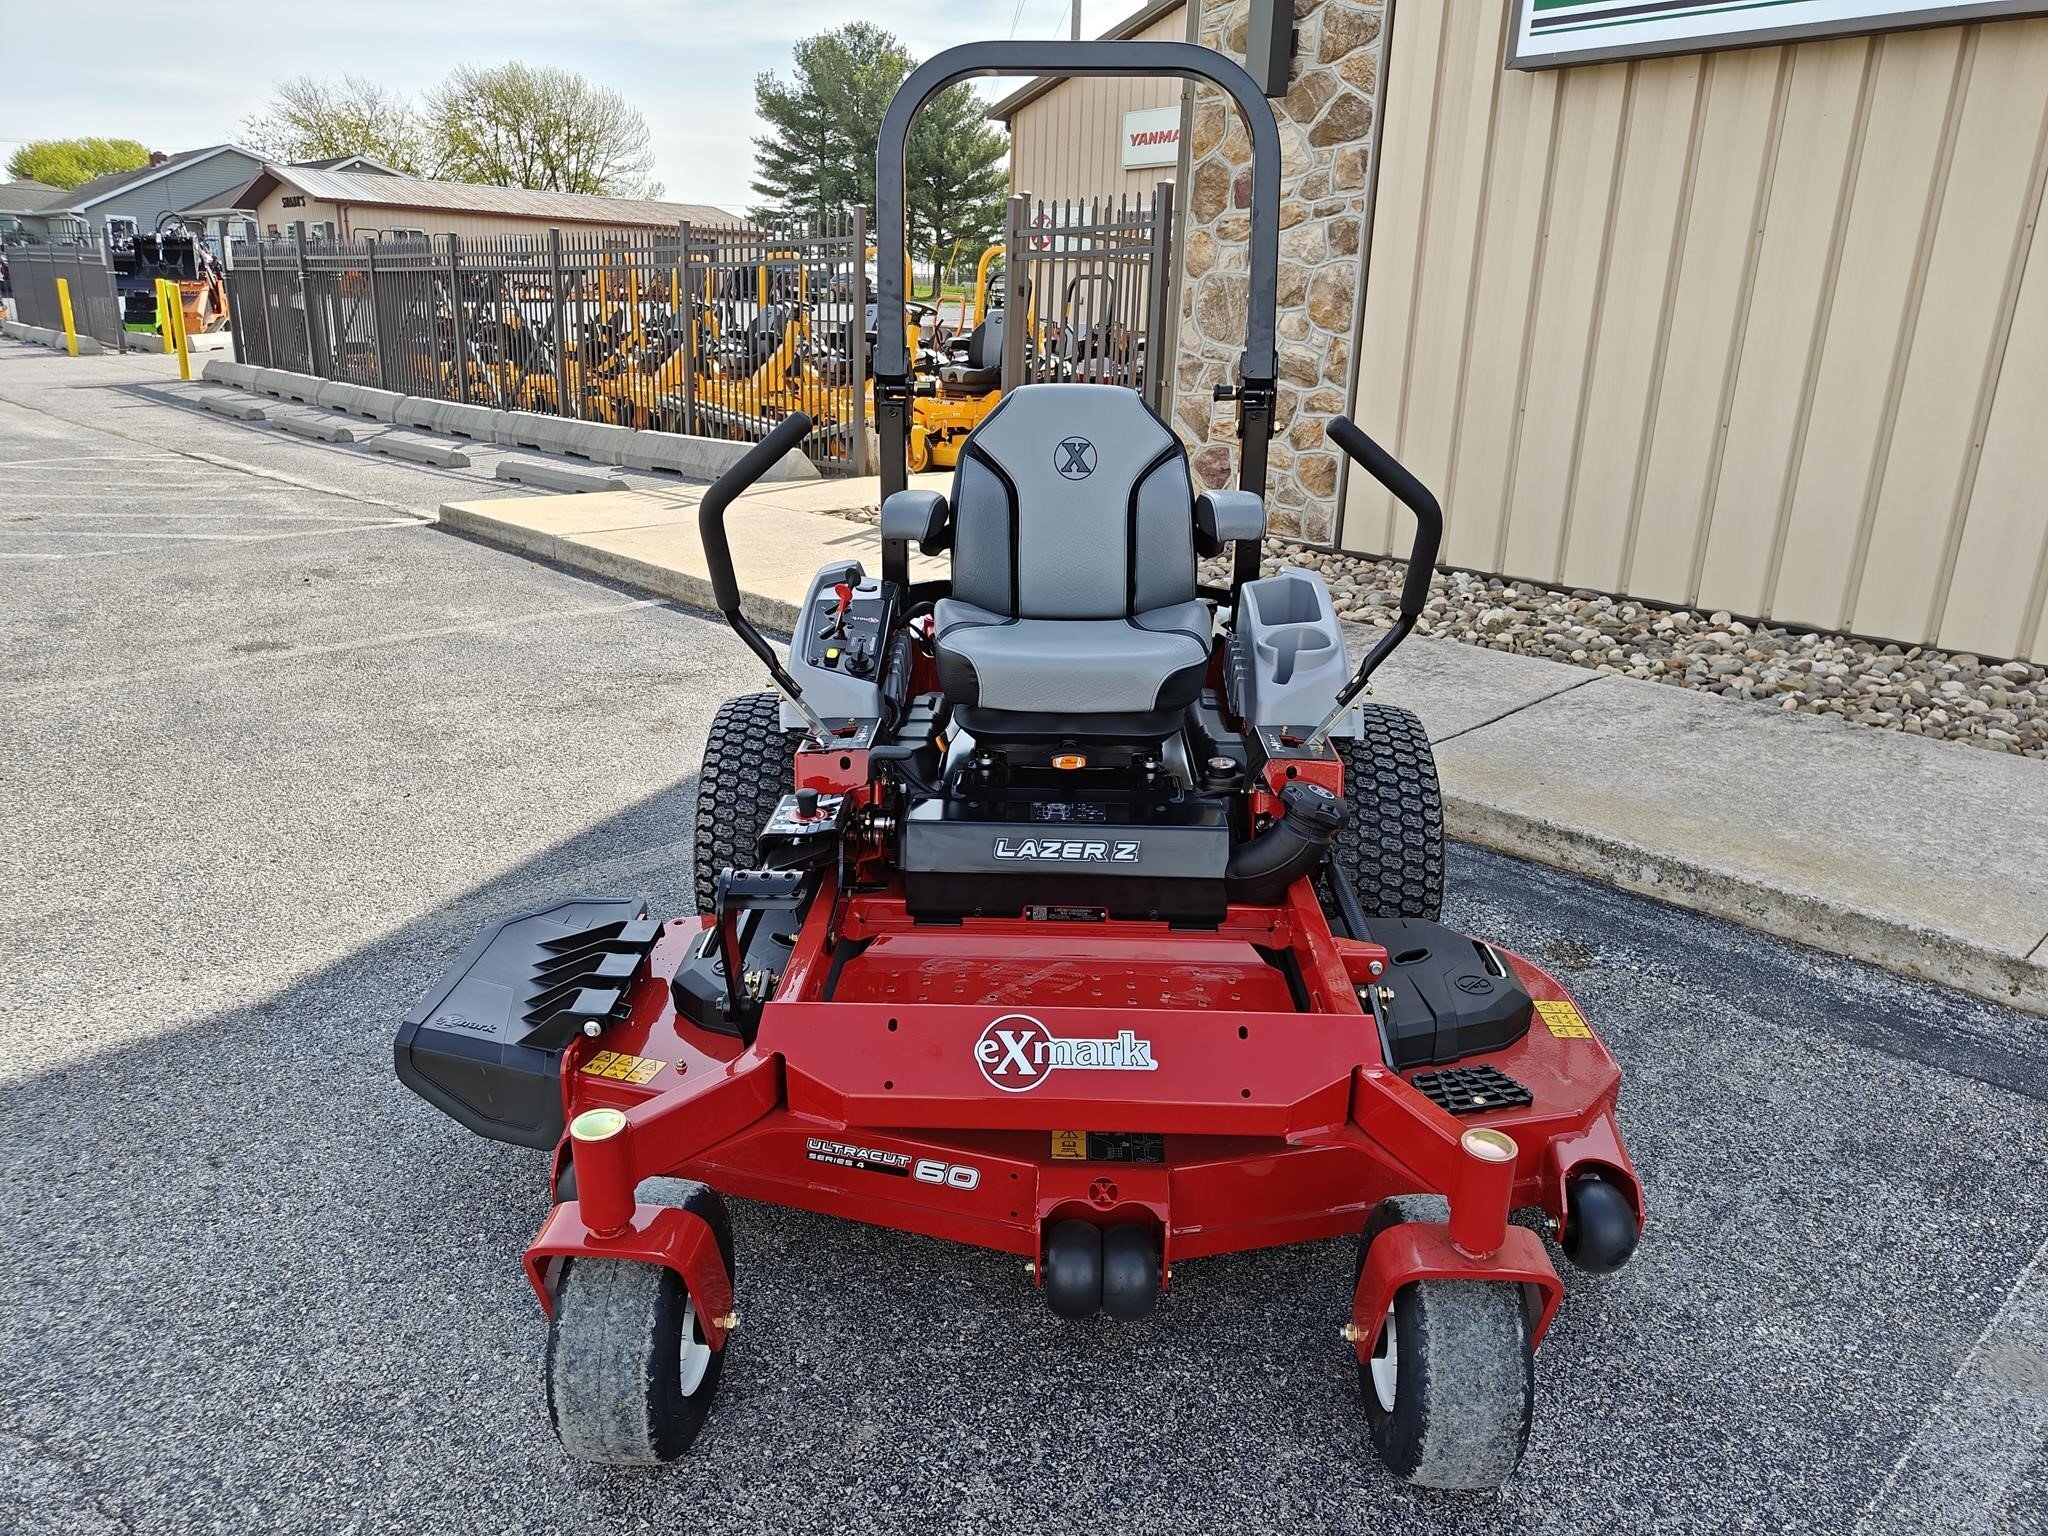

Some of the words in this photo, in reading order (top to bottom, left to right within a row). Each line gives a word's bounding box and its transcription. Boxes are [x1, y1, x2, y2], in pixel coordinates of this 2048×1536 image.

[994, 838, 1109, 862] LAZER
[1111, 841, 1140, 862] Z
[976, 1030, 1151, 1076] eXmark
[807, 1138, 912, 1168] ULTRACUT
[913, 1158, 981, 1191] 60
[809, 1152, 853, 1167] SERIES
[856, 1161, 865, 1169] 4
